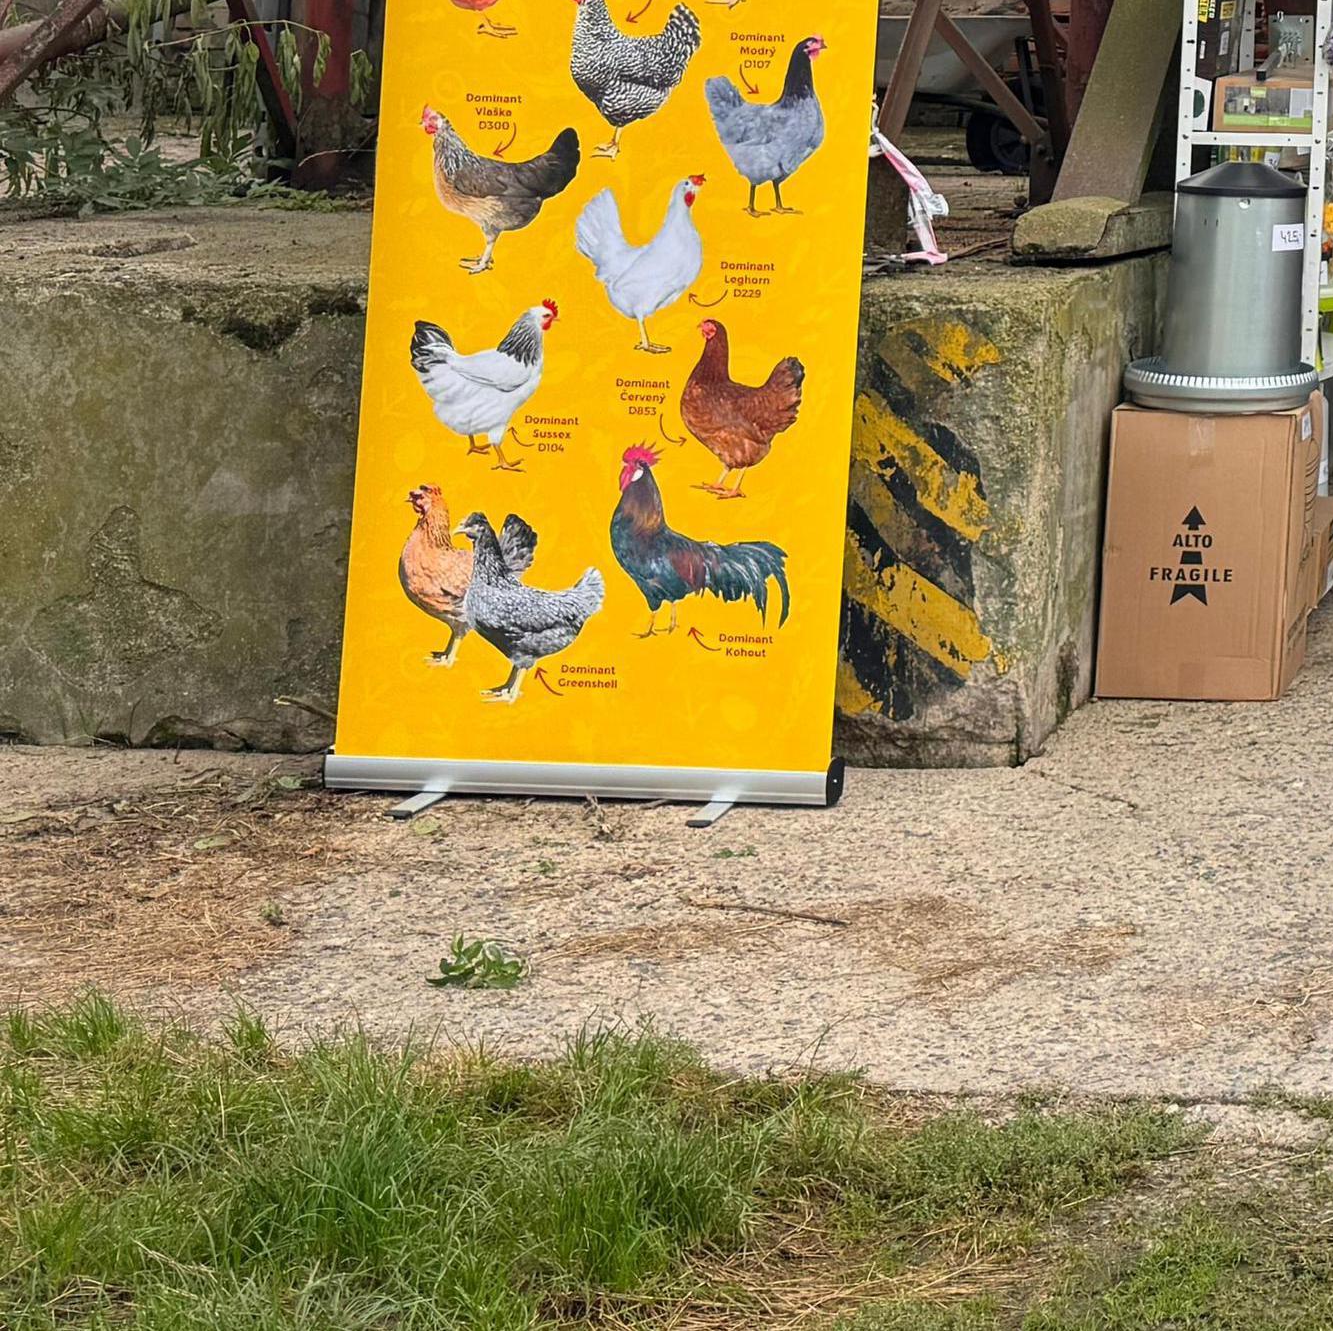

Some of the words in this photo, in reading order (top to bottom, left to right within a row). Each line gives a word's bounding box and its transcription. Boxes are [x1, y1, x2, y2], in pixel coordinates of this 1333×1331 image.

[730, 32, 784, 42] Dominant
[740, 46, 776, 57] Modrý
[744, 60, 771, 69] D107
[466, 93, 521, 103] Dominant
[475, 107, 512, 116] Vlaška
[479, 121, 509, 130] D300
[721, 262, 774, 271] Dominant
[725, 275, 770, 286] Leghorn
[734, 289, 761, 298] D229
[616, 378, 670, 391] Dominant
[620, 390, 666, 404] Červený
[525, 415, 579, 425] Dominant
[533, 429, 571, 439] Sussex
[538, 443, 564, 452] D104
[1173, 534, 1212, 548] ALTO
[1150, 567, 1232, 582] FRAGILE
[719, 634, 773, 644] Dominant
[726, 648, 765, 657] Kohout
[561, 665, 615, 675] Dominant
[558, 678, 617, 688] Greenshell
